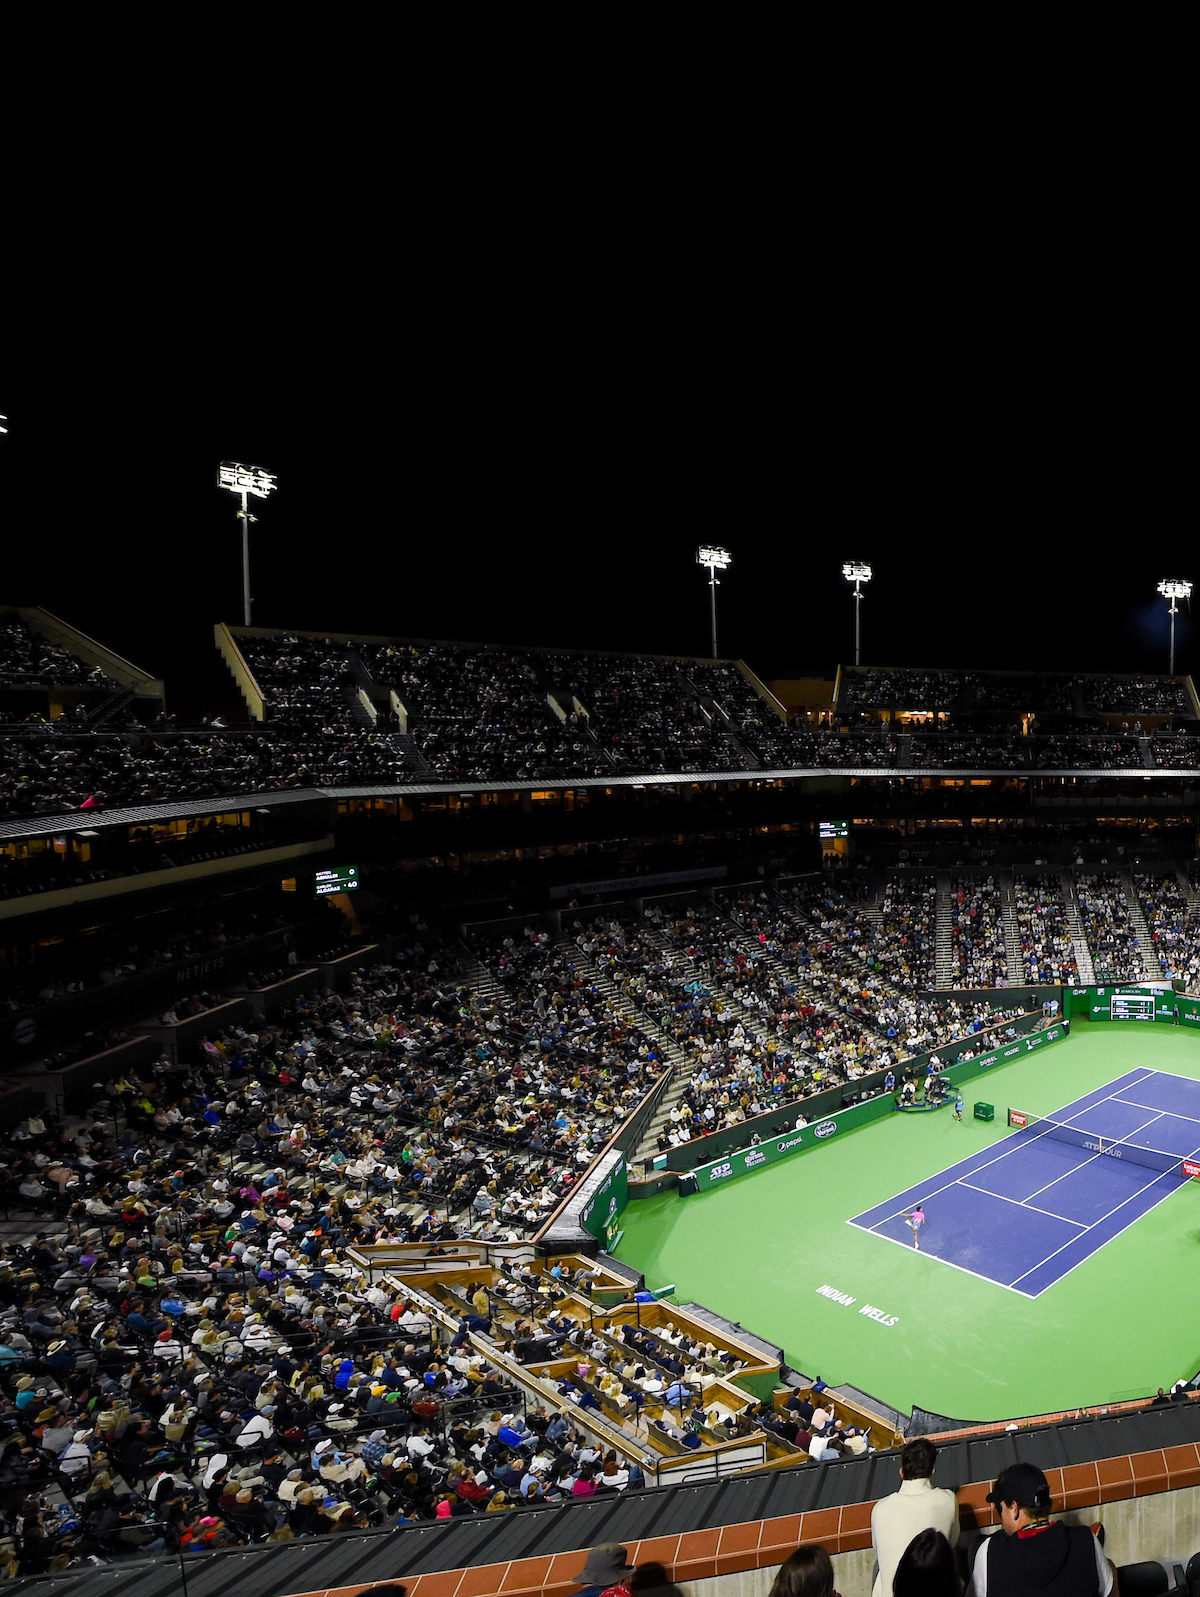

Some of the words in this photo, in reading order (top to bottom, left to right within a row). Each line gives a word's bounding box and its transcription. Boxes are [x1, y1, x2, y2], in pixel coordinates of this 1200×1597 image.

[348, 868, 356, 876] 0
[347, 880, 358, 888] 40
[176, 957, 224, 981] NETJETS
[786, 1136, 803, 1149] pepsi
[1082, 1141, 1100, 1151] ATP
[710, 1162, 731, 1177] ATP
[815, 1284, 857, 1307] INDIAN
[858, 1304, 900, 1327] WELLS
